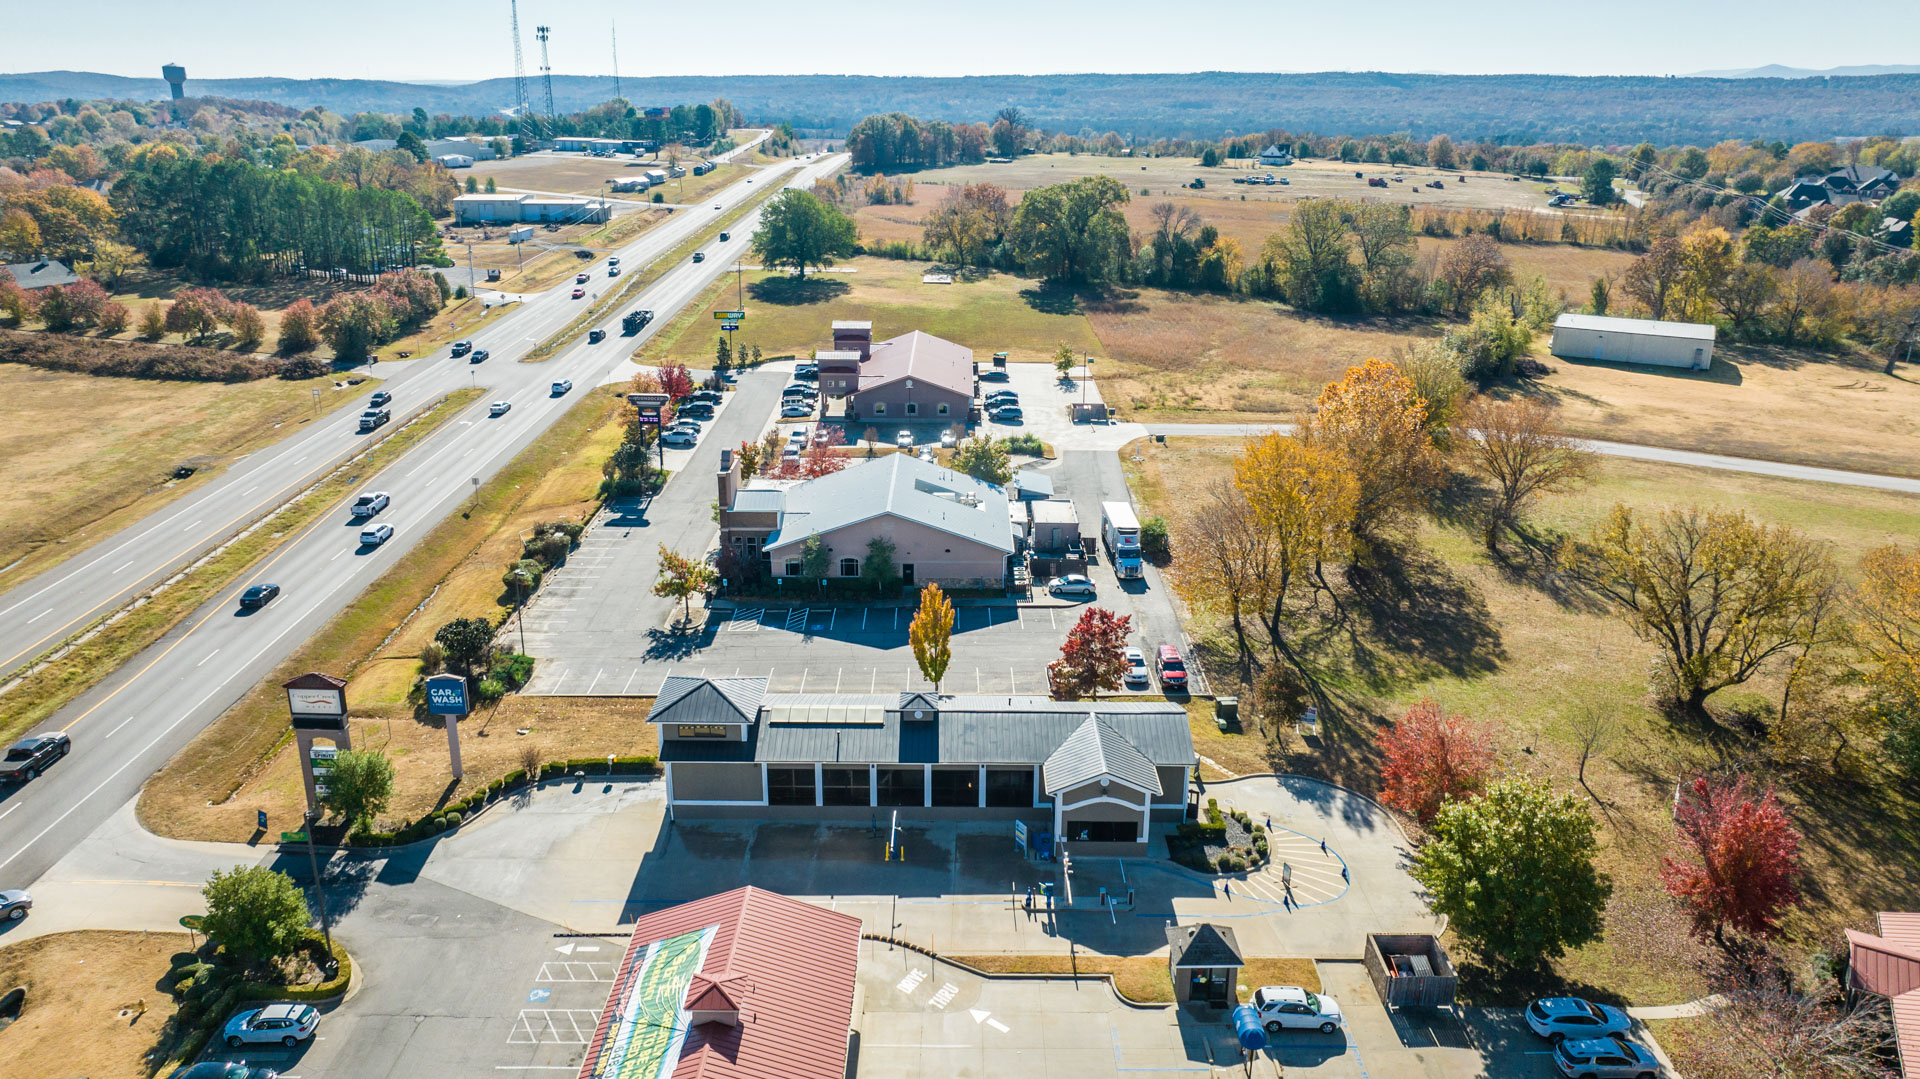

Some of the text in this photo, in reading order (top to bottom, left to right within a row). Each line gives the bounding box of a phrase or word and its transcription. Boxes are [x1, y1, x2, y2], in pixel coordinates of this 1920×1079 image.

[430, 688, 452, 696] CAR
[432, 696, 463, 704] WASH
[896, 967, 928, 995] DRIVE
[928, 981, 960, 1010] THRU
[643, 1031, 658, 1048] TO
[637, 1048, 652, 1065] BE
